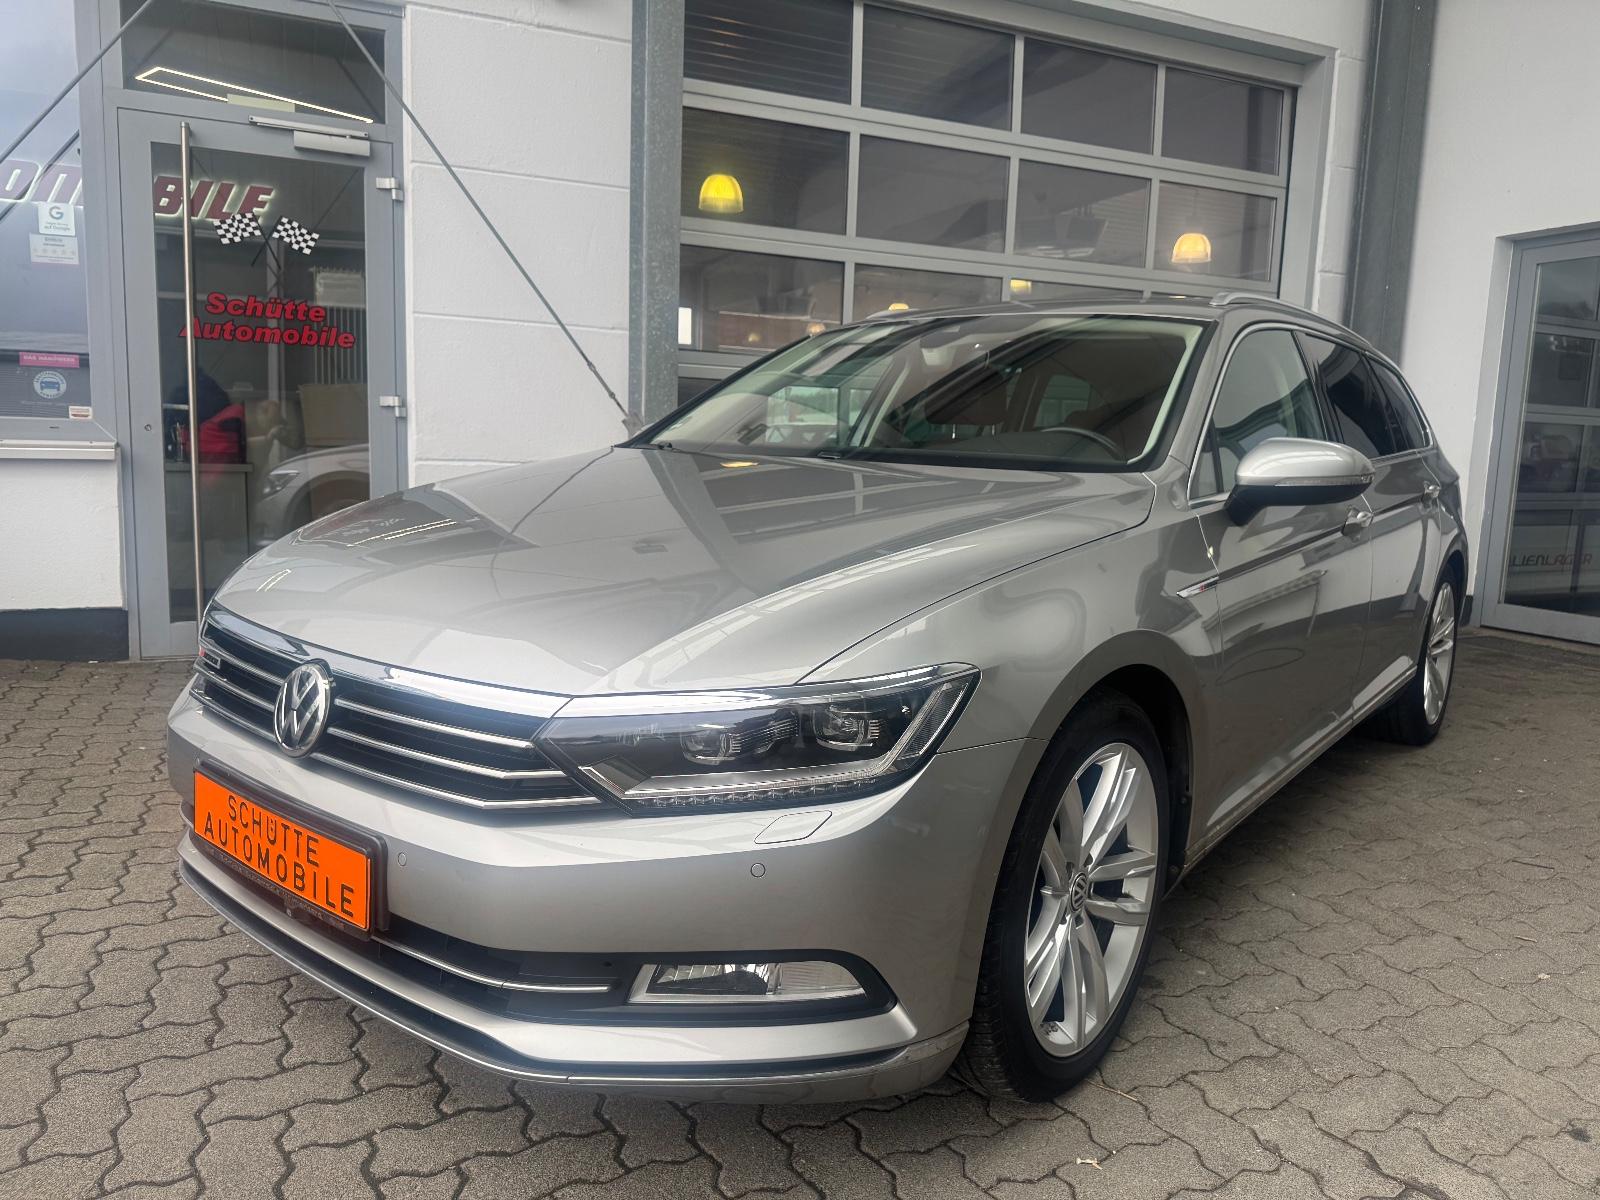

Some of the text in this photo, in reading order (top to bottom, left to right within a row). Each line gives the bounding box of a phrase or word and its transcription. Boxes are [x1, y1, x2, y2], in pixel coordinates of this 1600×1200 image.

[179, 317, 355, 348] Automobile
[205, 292, 326, 322] Schütte
[228, 795, 320, 868] SCHÜTTE
[204, 811, 354, 918] AUTOMOBILE
